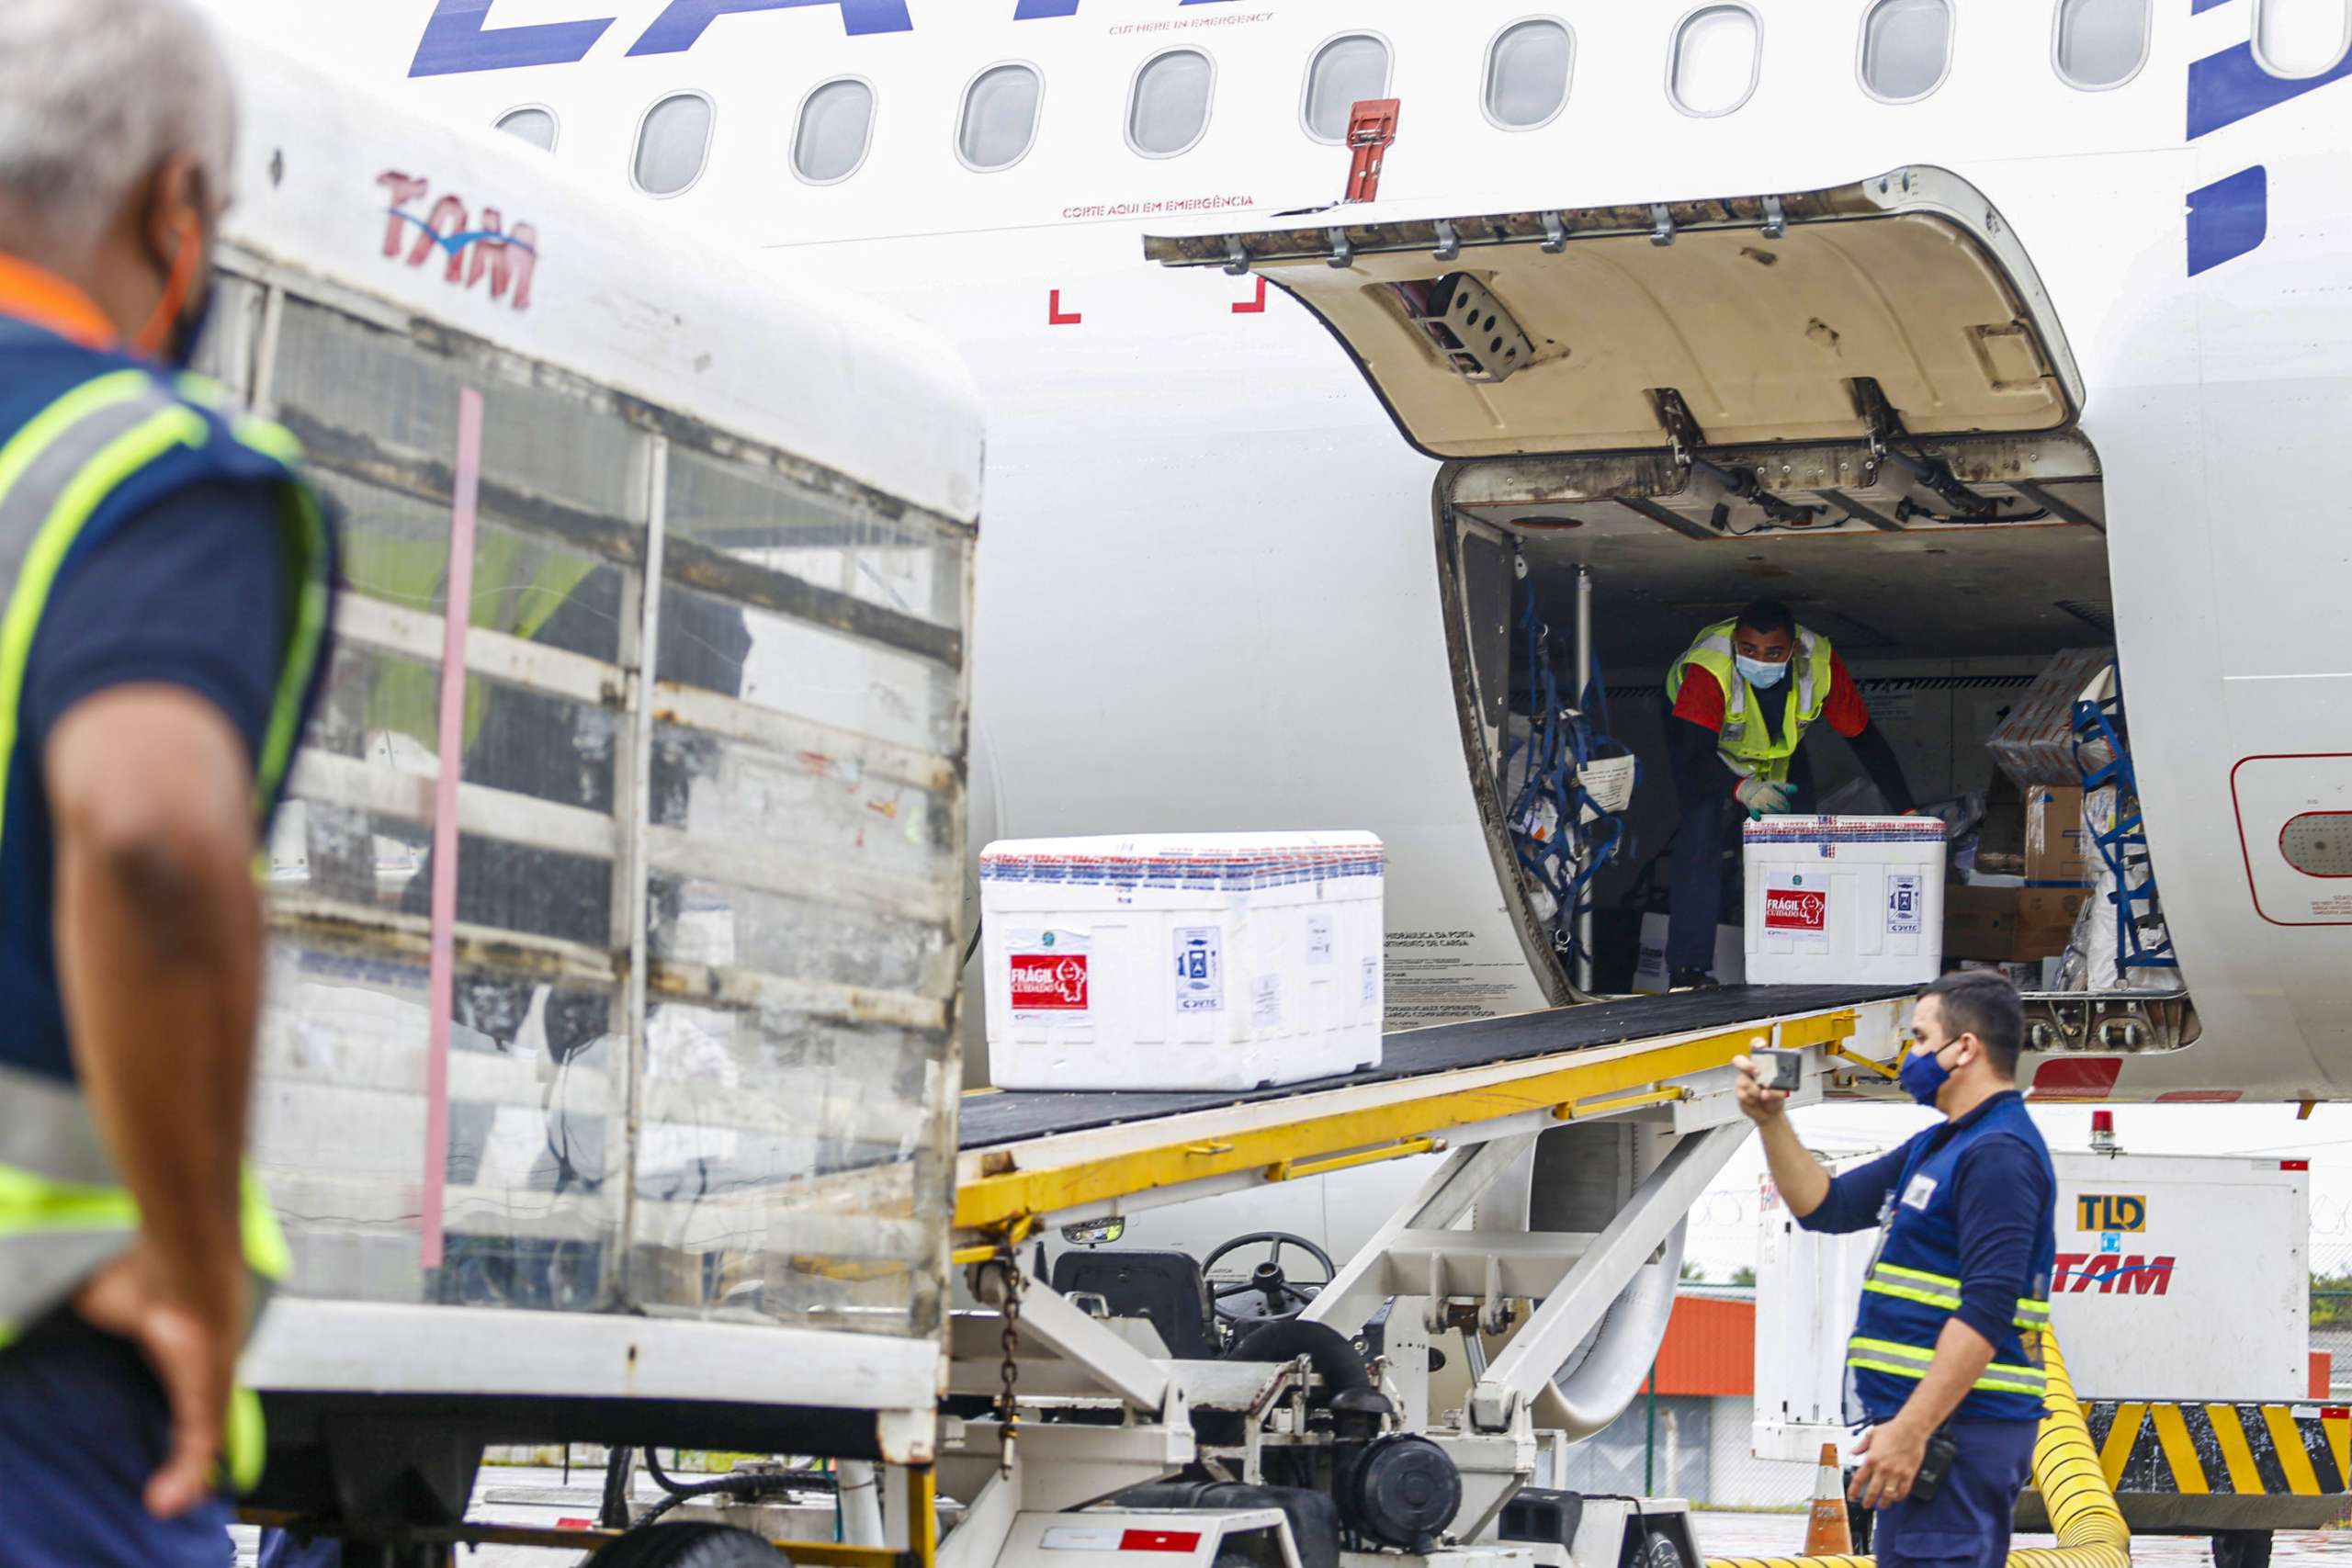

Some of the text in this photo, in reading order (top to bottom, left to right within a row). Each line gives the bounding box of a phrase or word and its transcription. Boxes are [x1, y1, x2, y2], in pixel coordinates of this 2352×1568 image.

[1109, 11, 1274, 35] CUT HERE IN EMERGENCY
[1062, 195, 1255, 219] CORTE AQUI EM EMERGÊNCIA
[375, 169, 540, 311] TAM
[1767, 909, 1799, 918] CUIDADO
[1768, 897, 1799, 910] FRÁGIL
[1012, 965, 1055, 982] FRÁGIL
[1012, 983, 1055, 993] CUIDADO
[2079, 1195, 2145, 1230] TLD
[2052, 1253, 2176, 1296] TAM
